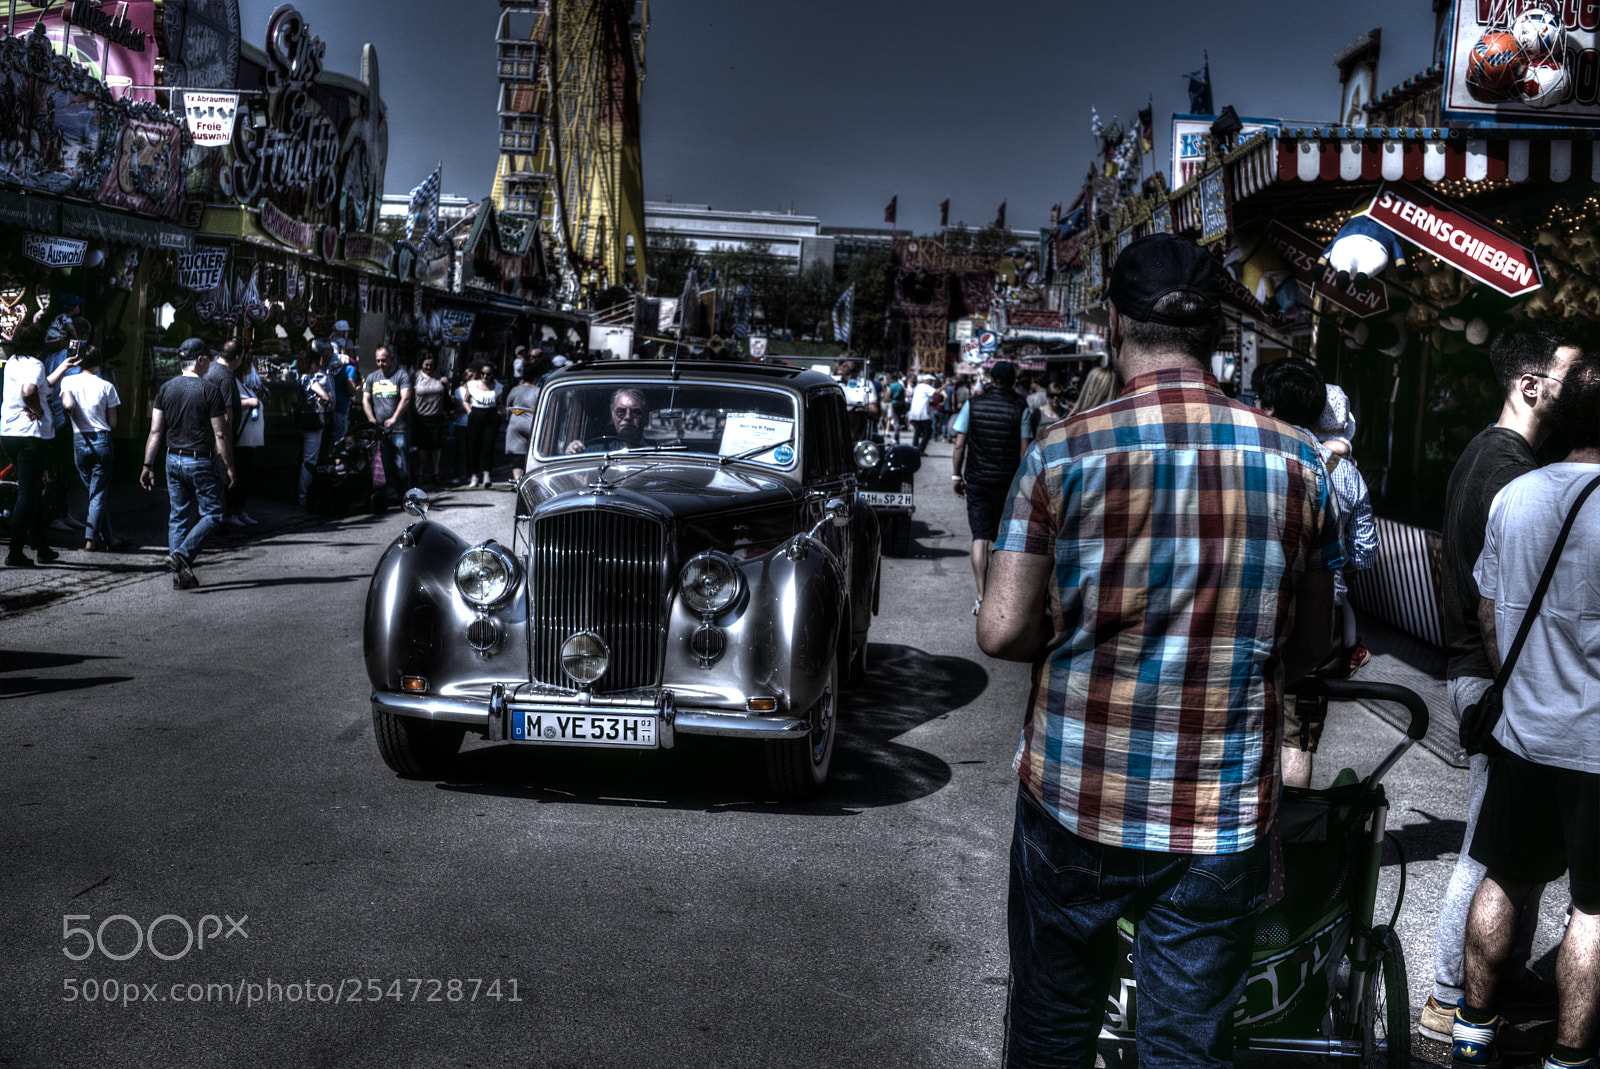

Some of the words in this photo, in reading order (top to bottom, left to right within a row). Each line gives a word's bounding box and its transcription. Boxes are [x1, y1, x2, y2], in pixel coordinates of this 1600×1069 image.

[196, 95, 235, 103] Abräumen
[196, 121, 222, 131] Freie
[191, 131, 230, 141] Auswahl
[26, 241, 46, 259] Freie
[47, 245, 82, 263] Auswahl
[178, 254, 225, 271] ZUCKER-
[180, 268, 220, 285] WATTE
[884, 494, 896, 504] SP
[526, 714, 542, 737] M
